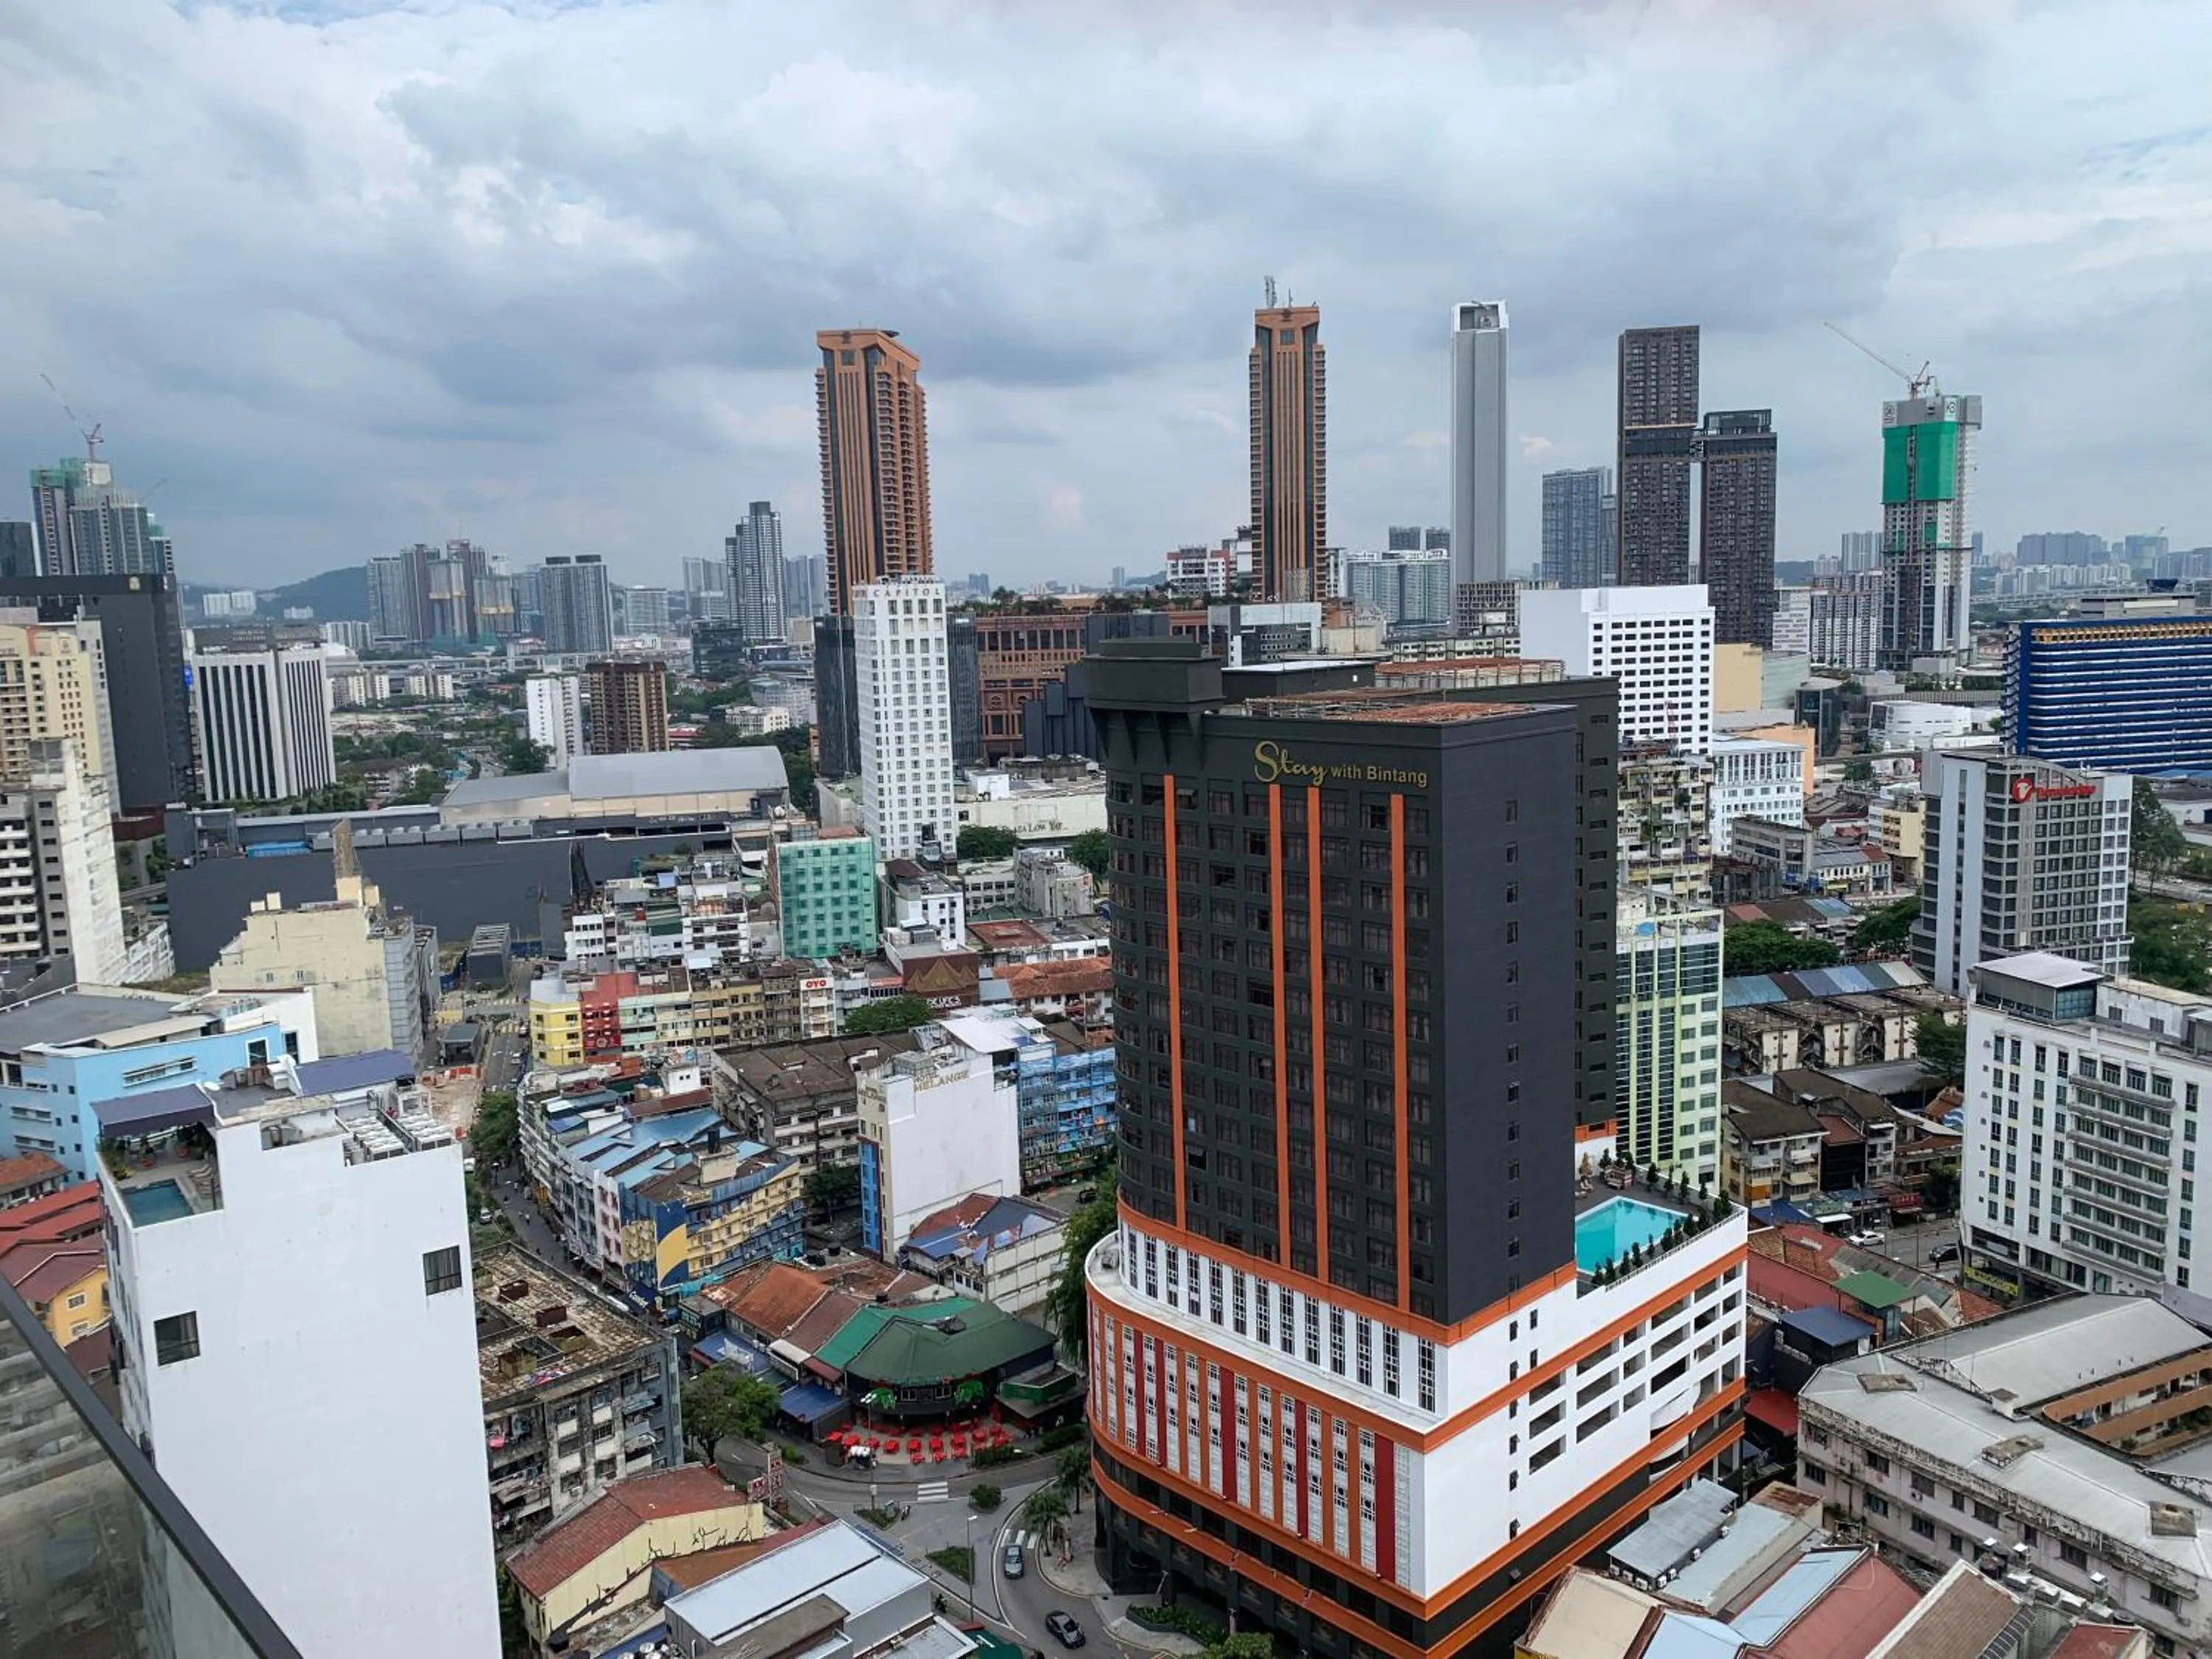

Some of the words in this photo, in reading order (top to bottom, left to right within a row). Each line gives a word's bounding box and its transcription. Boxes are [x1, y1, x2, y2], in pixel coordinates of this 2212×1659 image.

[873, 588, 941, 597] CAPITOL
[1255, 740, 1326, 786] Stay
[1331, 764, 1362, 779] with
[1367, 765, 1427, 787] Bintang
[806, 979, 827, 988] OYO
